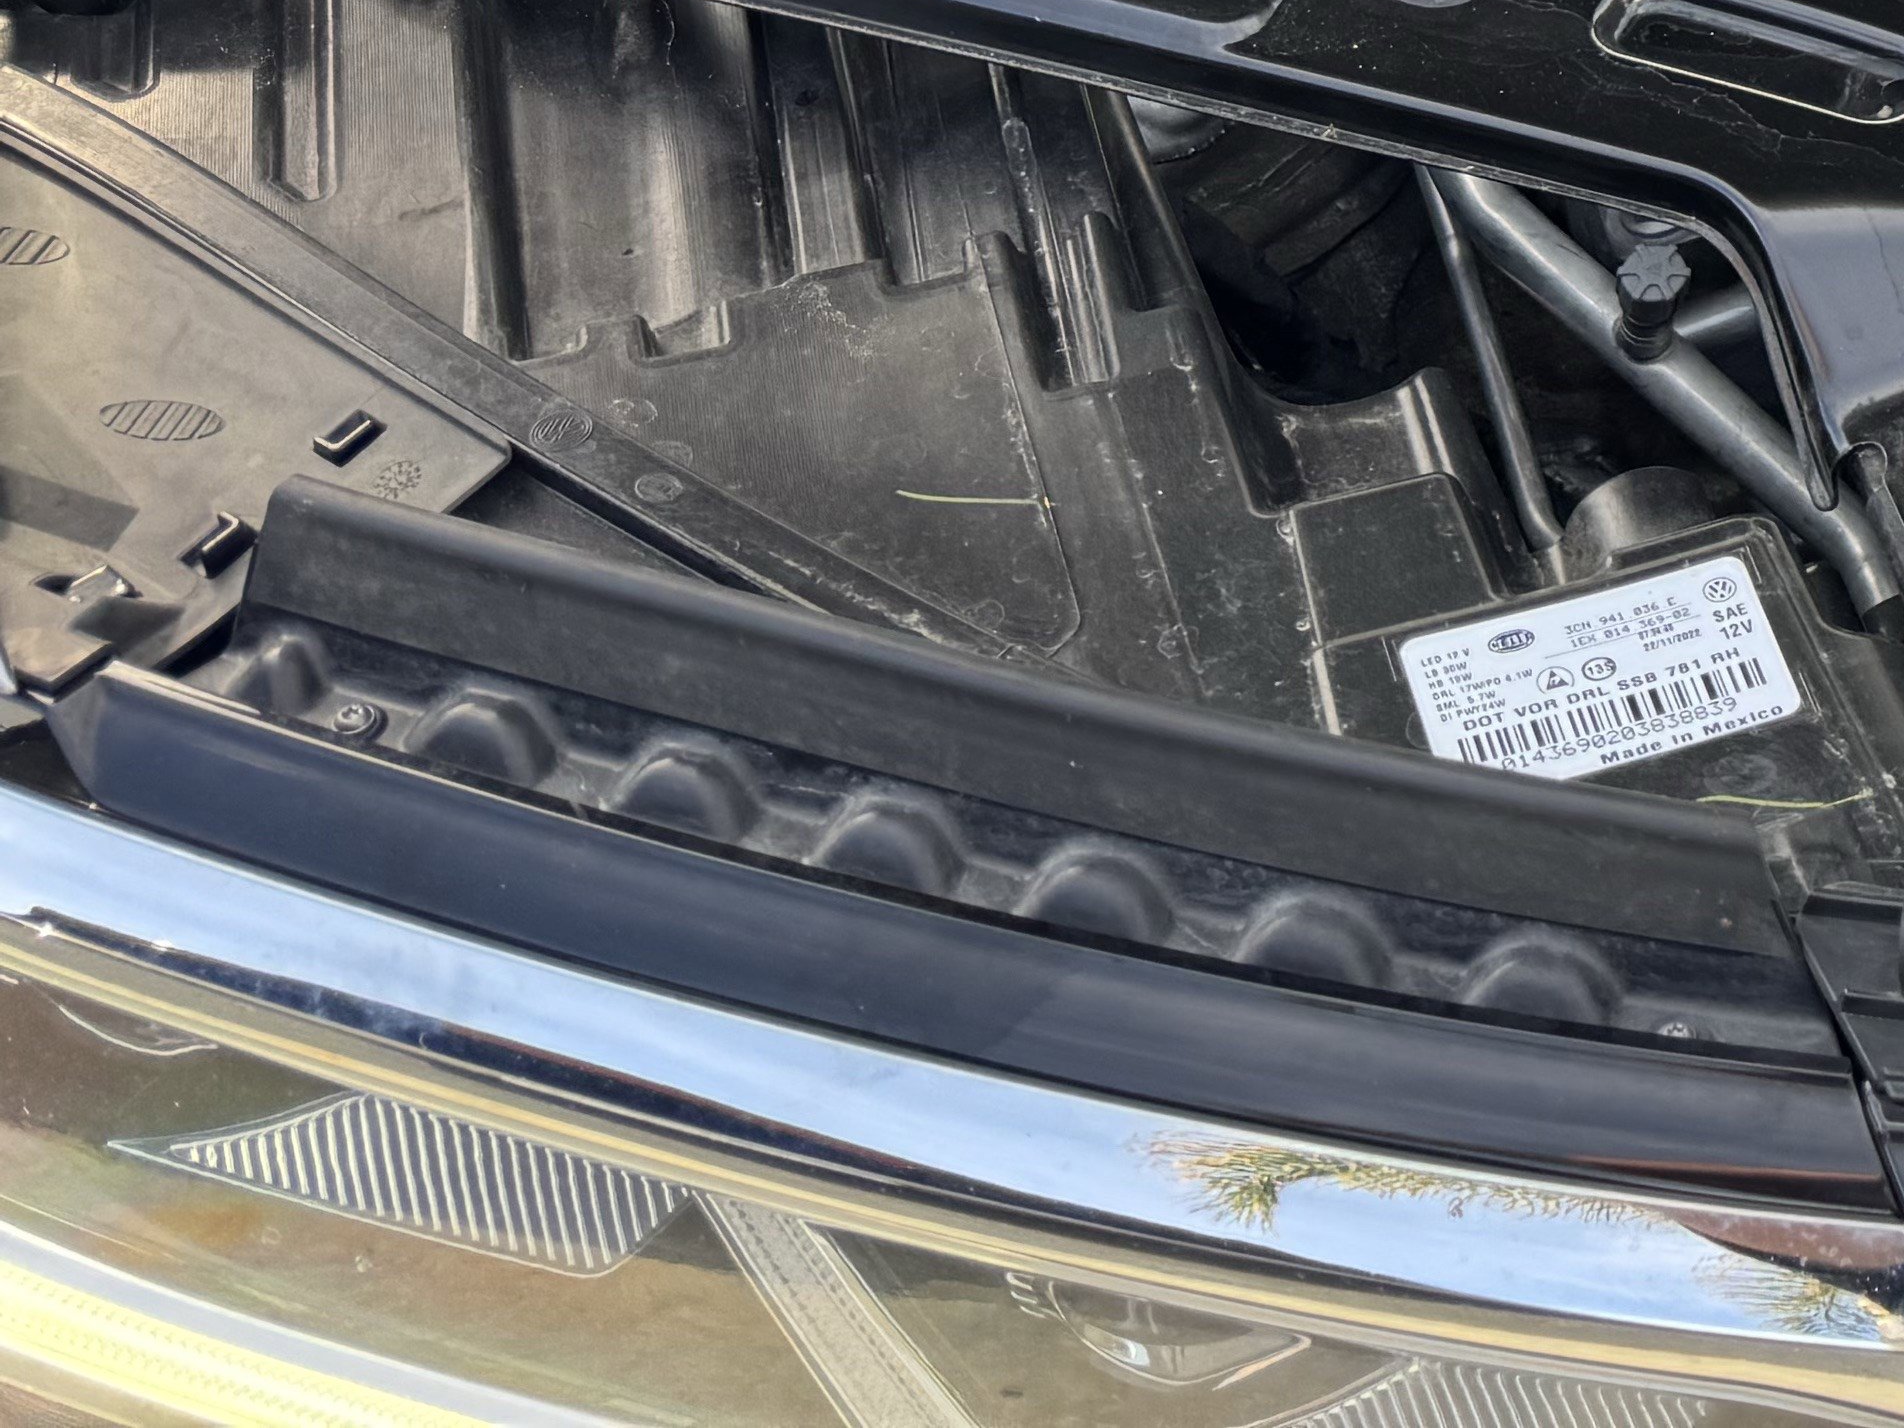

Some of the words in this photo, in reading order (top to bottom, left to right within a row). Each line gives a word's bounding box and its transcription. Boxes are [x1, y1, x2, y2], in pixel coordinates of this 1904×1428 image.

[1638, 606, 1690, 629] 369-02
[1712, 602, 1748, 623] SAE
[1718, 618, 1752, 639] 12V
[1462, 711, 1503, 731] DOT
[1513, 698, 1558, 717] VOR
[1565, 686, 1610, 704] DRL
[1616, 671, 1657, 691] SSB
[1664, 658, 1701, 677] 781
[1709, 646, 1740, 664] RH
[1599, 741, 1662, 764] Made
[1670, 731, 1693, 745] in
[1701, 705, 1786, 736] Mexico
